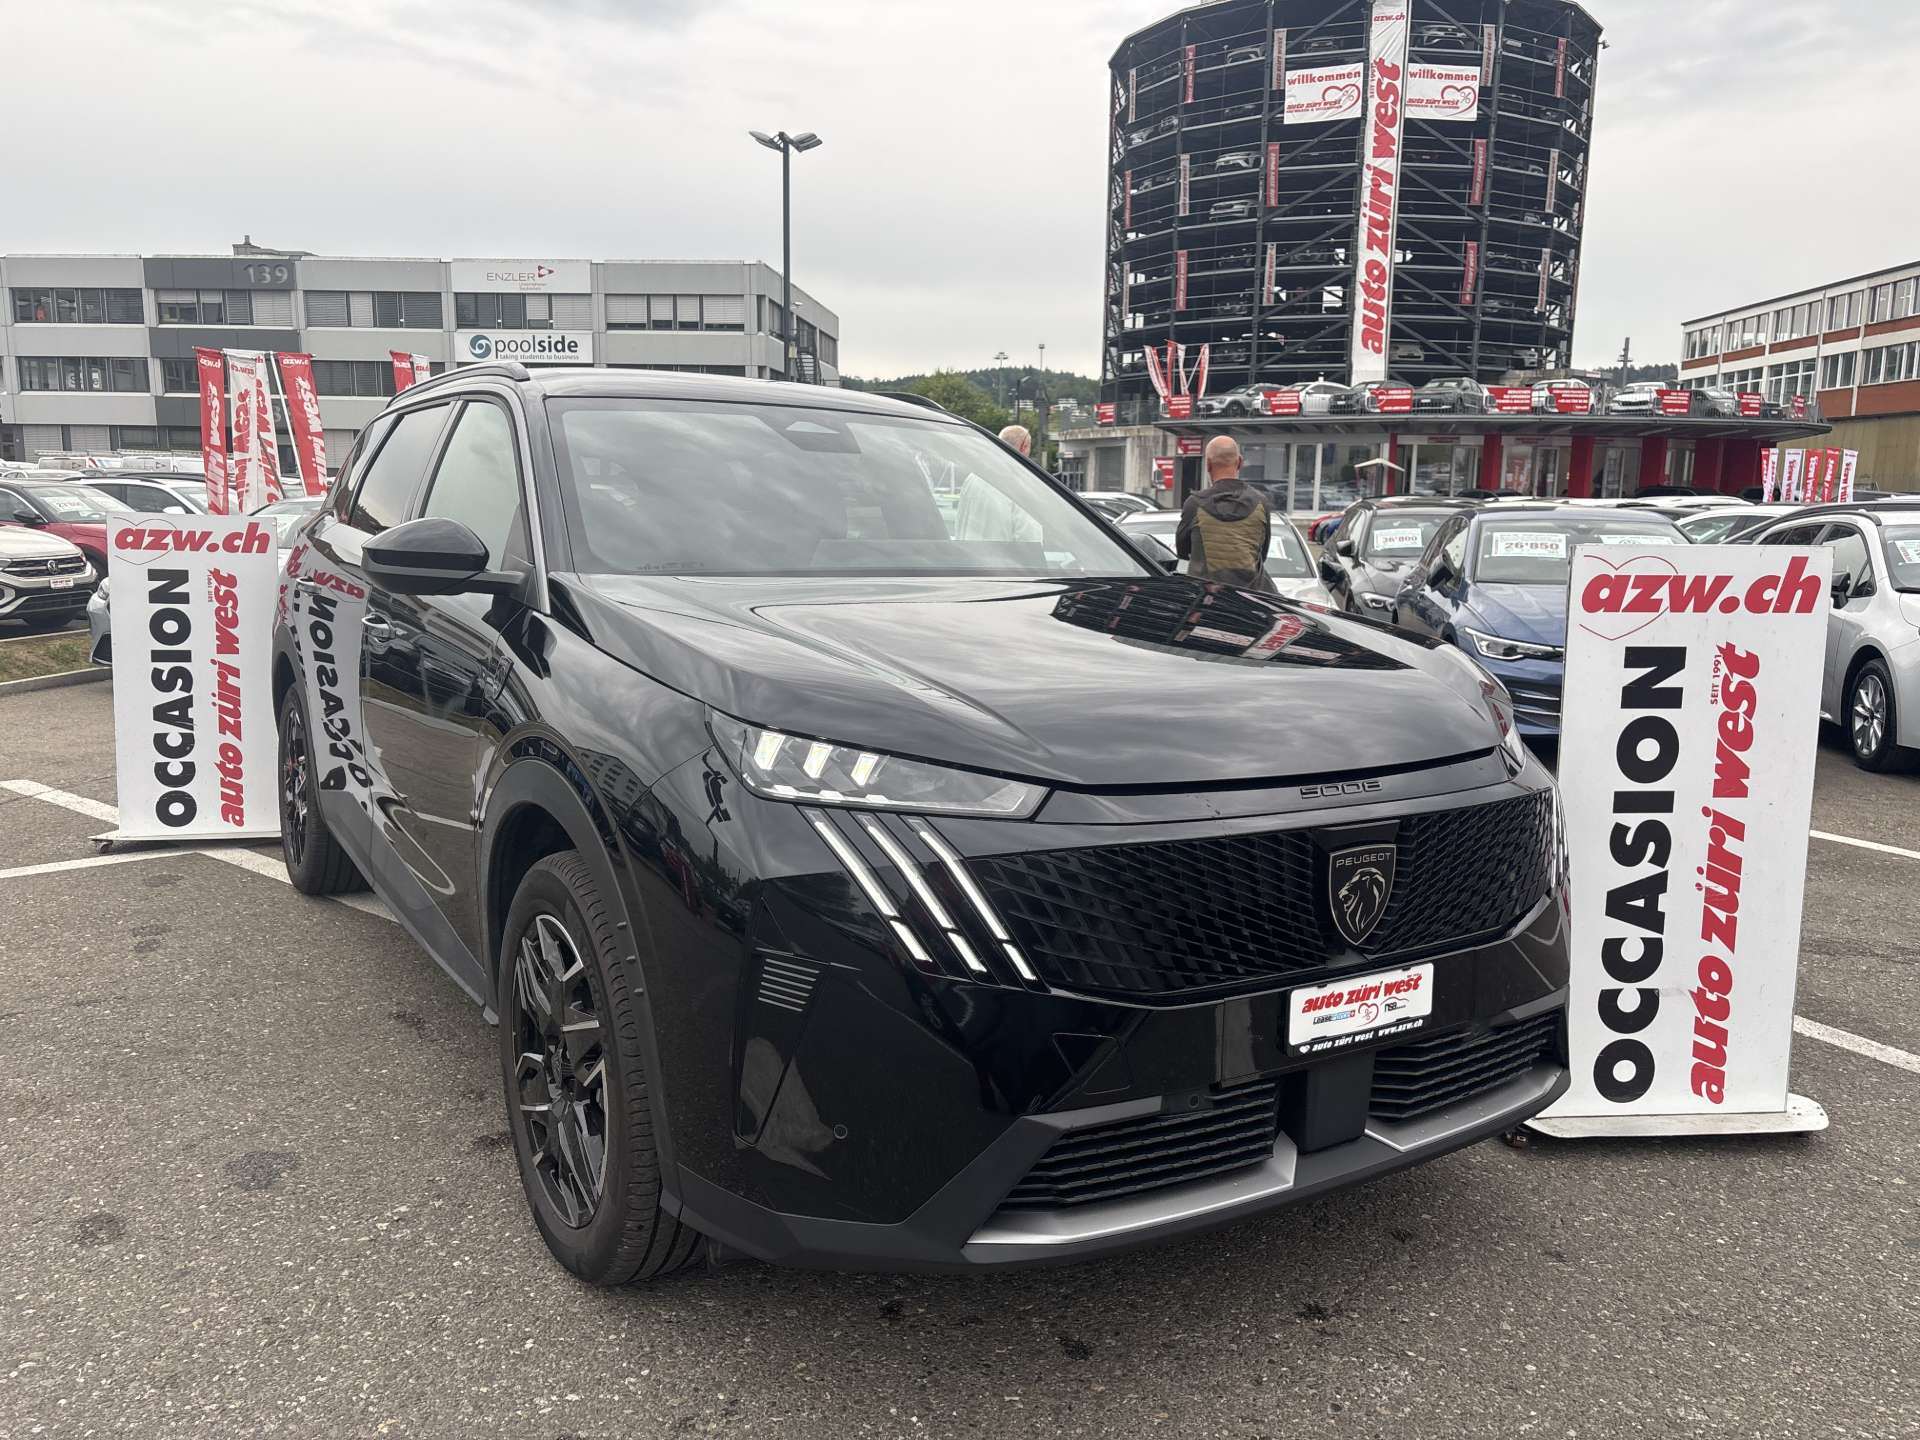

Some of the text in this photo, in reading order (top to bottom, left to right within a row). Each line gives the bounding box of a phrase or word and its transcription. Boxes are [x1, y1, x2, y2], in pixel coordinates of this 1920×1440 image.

[1374, 13, 1405, 22] azw.ch
[1287, 71, 1361, 85] willkommen
[1409, 69, 1478, 81] willkommen
[1360, 57, 1401, 354] auto züri west
[245, 265, 288, 283] 139
[487, 273, 535, 281] ENZLER
[495, 335, 578, 359] poolside
[114, 522, 271, 554] azw.ch
[1580, 556, 1822, 614] azw.ch
[1710, 653, 1721, 705] SEIT 1991
[147, 568, 198, 828] OCCASION
[209, 567, 245, 827] auto züri west
[1300, 781, 1383, 799] 5008
[1336, 852, 1392, 867] PEUGEOT
[1593, 646, 1688, 1103] OCCASION
[1690, 641, 1760, 1105] auto züri west
[1302, 974, 1422, 1013] auto züri west
[1312, 1018, 1424, 1051] auto züri west www.azw.ch
